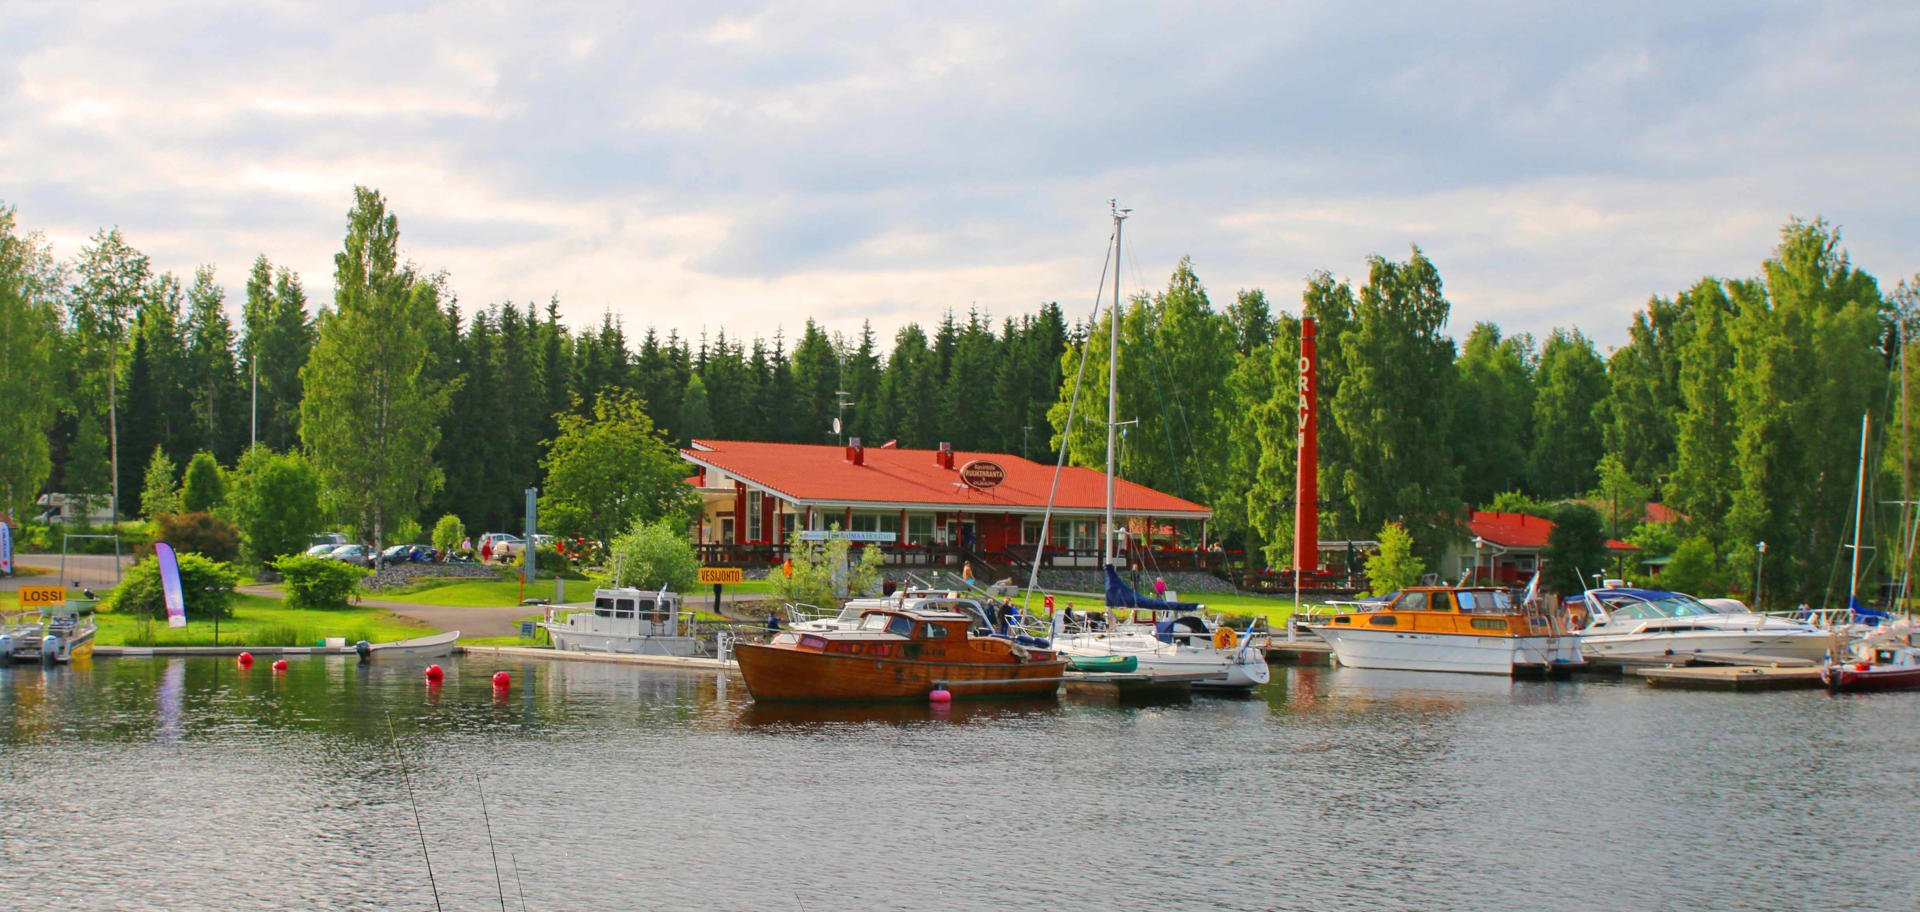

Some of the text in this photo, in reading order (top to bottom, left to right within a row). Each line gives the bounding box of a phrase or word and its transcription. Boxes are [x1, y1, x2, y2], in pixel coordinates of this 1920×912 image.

[1298, 356, 1310, 448] ORAVI
[702, 570, 740, 581] VESIJOHTO
[23, 591, 62, 602] LOSSI
